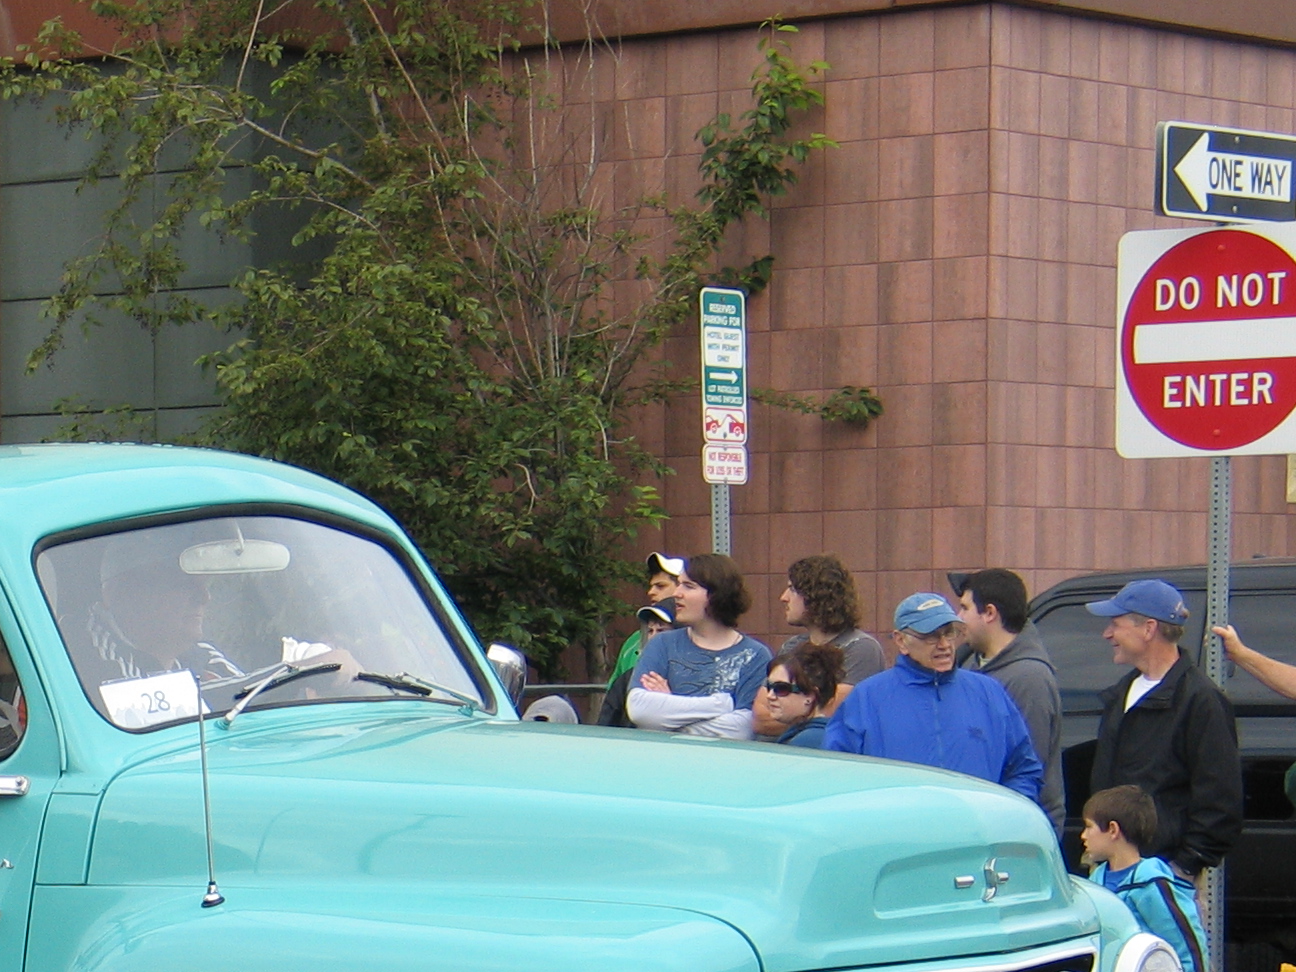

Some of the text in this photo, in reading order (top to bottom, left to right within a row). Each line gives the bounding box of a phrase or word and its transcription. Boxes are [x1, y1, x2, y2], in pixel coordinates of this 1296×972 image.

[1208, 156, 1288, 197] ONE WAY
[1155, 271, 1287, 312] DO NOT
[704, 314, 741, 327] PARKING FOR
[707, 331, 723, 340] HOTEL
[722, 343, 740, 351] PERMIT
[1162, 372, 1274, 409] ENTER
[140, 690, 171, 714] 28
